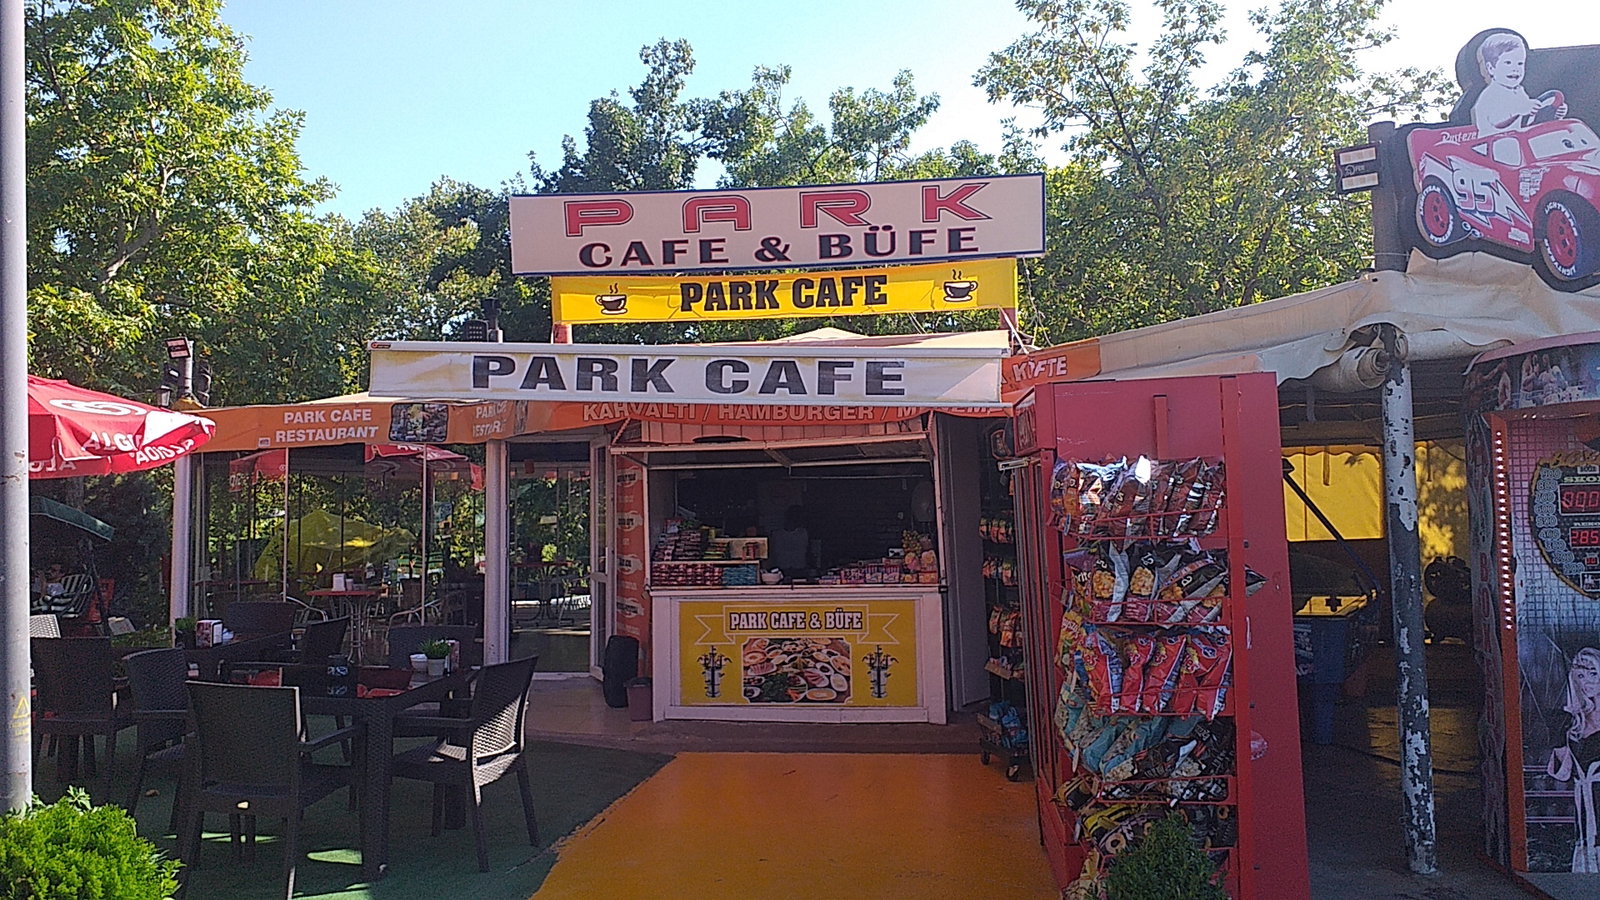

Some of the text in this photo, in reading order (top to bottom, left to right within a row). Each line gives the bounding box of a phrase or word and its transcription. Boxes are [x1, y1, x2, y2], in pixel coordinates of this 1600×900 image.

[1452, 170, 1495, 211] 95
[563, 184, 992, 237] PARK
[579, 225, 979, 268] CAFE & BÜFE
[680, 274, 888, 312] PARK CAFE
[471, 355, 905, 396] PARK CAFE
[283, 408, 372, 425] PARK CAFE
[582, 402, 696, 421] KAHVALTI
[718, 405, 874, 421] HAMBURGER
[275, 426, 379, 443] RESTAURANT
[730, 608, 863, 630] PARK CAFE & BÜFE
